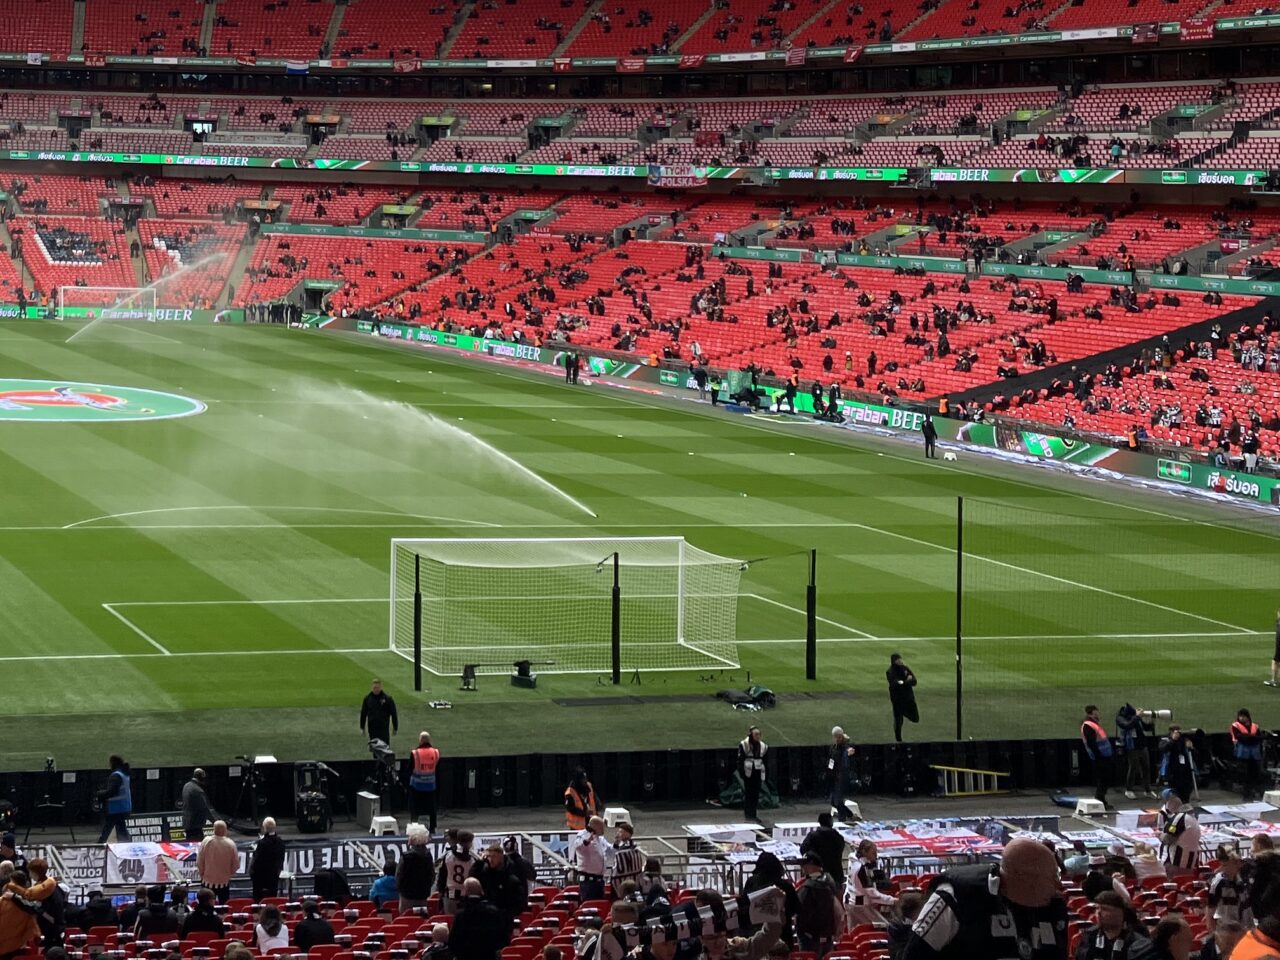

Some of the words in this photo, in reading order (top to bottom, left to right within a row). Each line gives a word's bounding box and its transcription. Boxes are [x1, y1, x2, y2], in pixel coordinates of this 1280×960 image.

[176, 155, 218, 166] Carabao
[220, 156, 249, 166] BEER
[566, 165, 607, 176] Carabao
[607, 166, 636, 176] BEER
[664, 167, 691, 176] TYCHY
[932, 170, 958, 182] abao
[959, 169, 989, 182] BEER
[662, 177, 694, 187] POLSKA
[156, 309, 193, 321] BEER
[516, 343, 540, 362] BEER
[842, 405, 889, 425] arabao
[892, 409, 932, 432] BEE
[453, 865, 465, 883] 8
